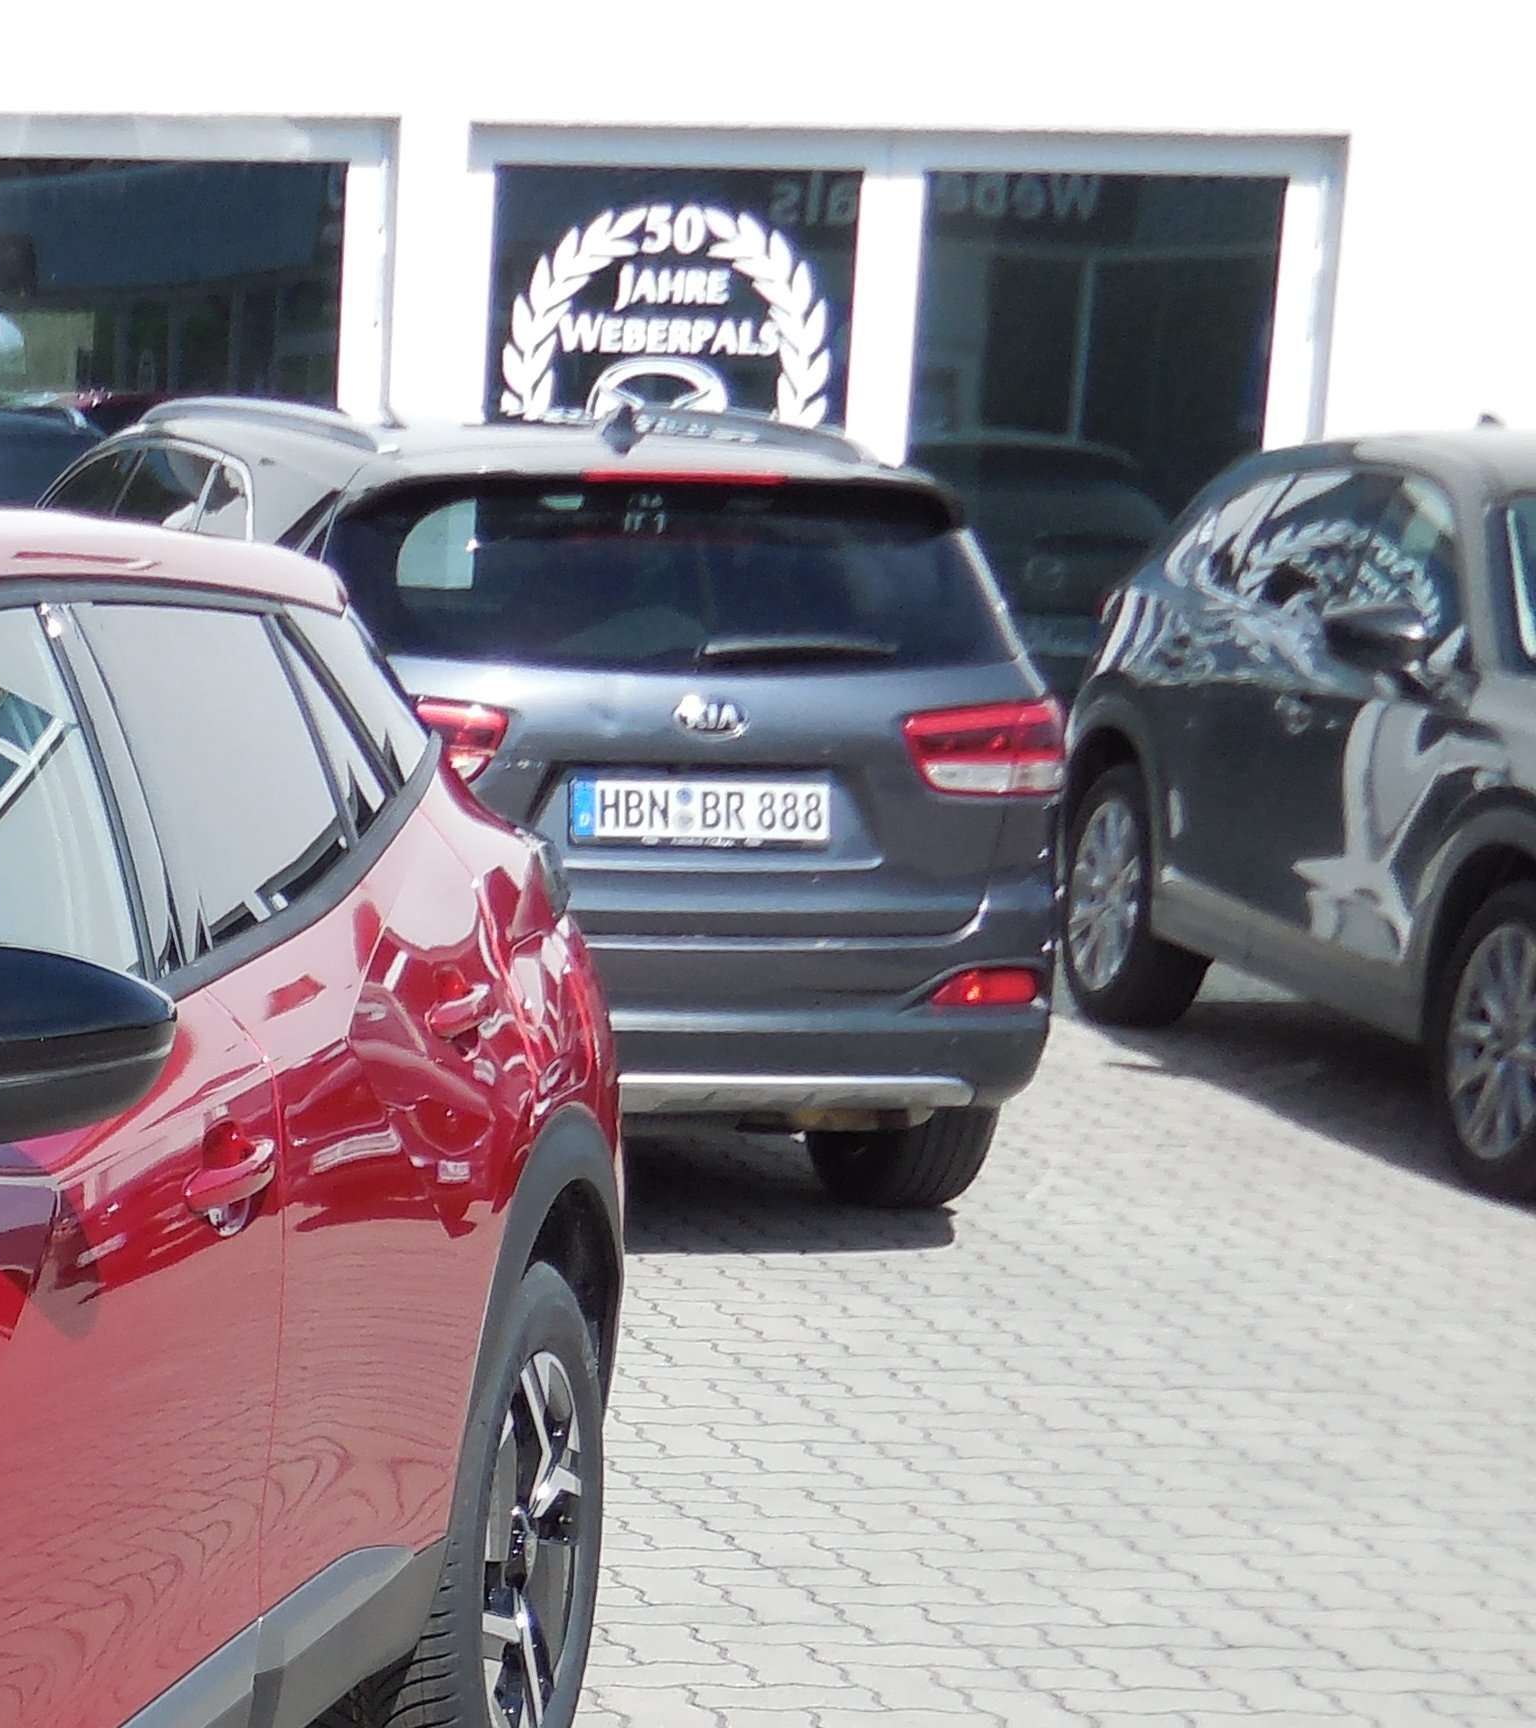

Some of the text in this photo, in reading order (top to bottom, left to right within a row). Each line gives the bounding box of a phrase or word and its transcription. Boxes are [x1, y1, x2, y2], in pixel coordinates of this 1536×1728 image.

[639, 203, 707, 255] 50
[614, 263, 732, 311] JAHRE
[558, 311, 784, 358] WEBERPALS
[599, 788, 670, 829] HBN
[700, 790, 746, 830] BR
[757, 791, 824, 832] 888
